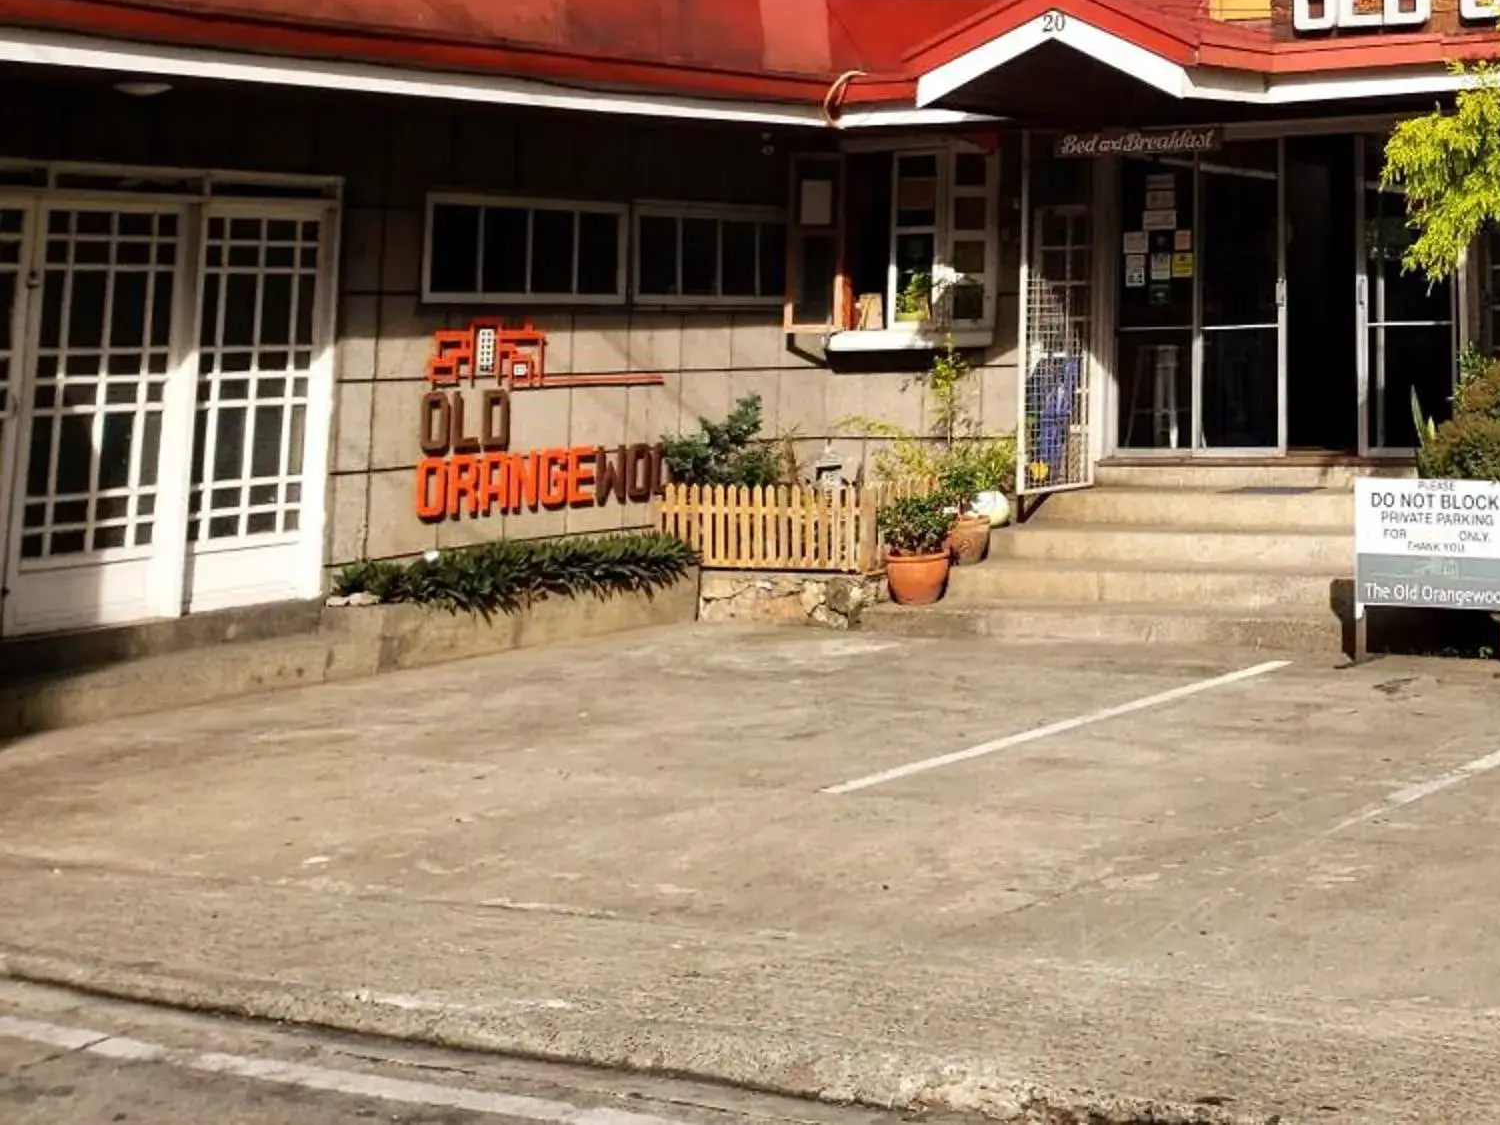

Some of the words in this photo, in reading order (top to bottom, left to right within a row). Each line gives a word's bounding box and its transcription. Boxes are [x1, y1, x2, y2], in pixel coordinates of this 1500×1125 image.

[1042, 14, 1066, 33] 20
[1061, 132, 1100, 154] Bed
[1122, 127, 1216, 153] Breakfast
[419, 388, 512, 457] OLD
[1417, 480, 1456, 492] PLEASE
[1370, 492, 1395, 508] DO
[1400, 493, 1435, 509] NOT
[1380, 510, 1433, 525] PRIVATE
[1436, 512, 1495, 527] PARKING
[1383, 528, 1407, 540] FOR
[1407, 541, 1441, 552] THANK
[1363, 582, 1390, 601] The
[1393, 583, 1419, 601] Old
